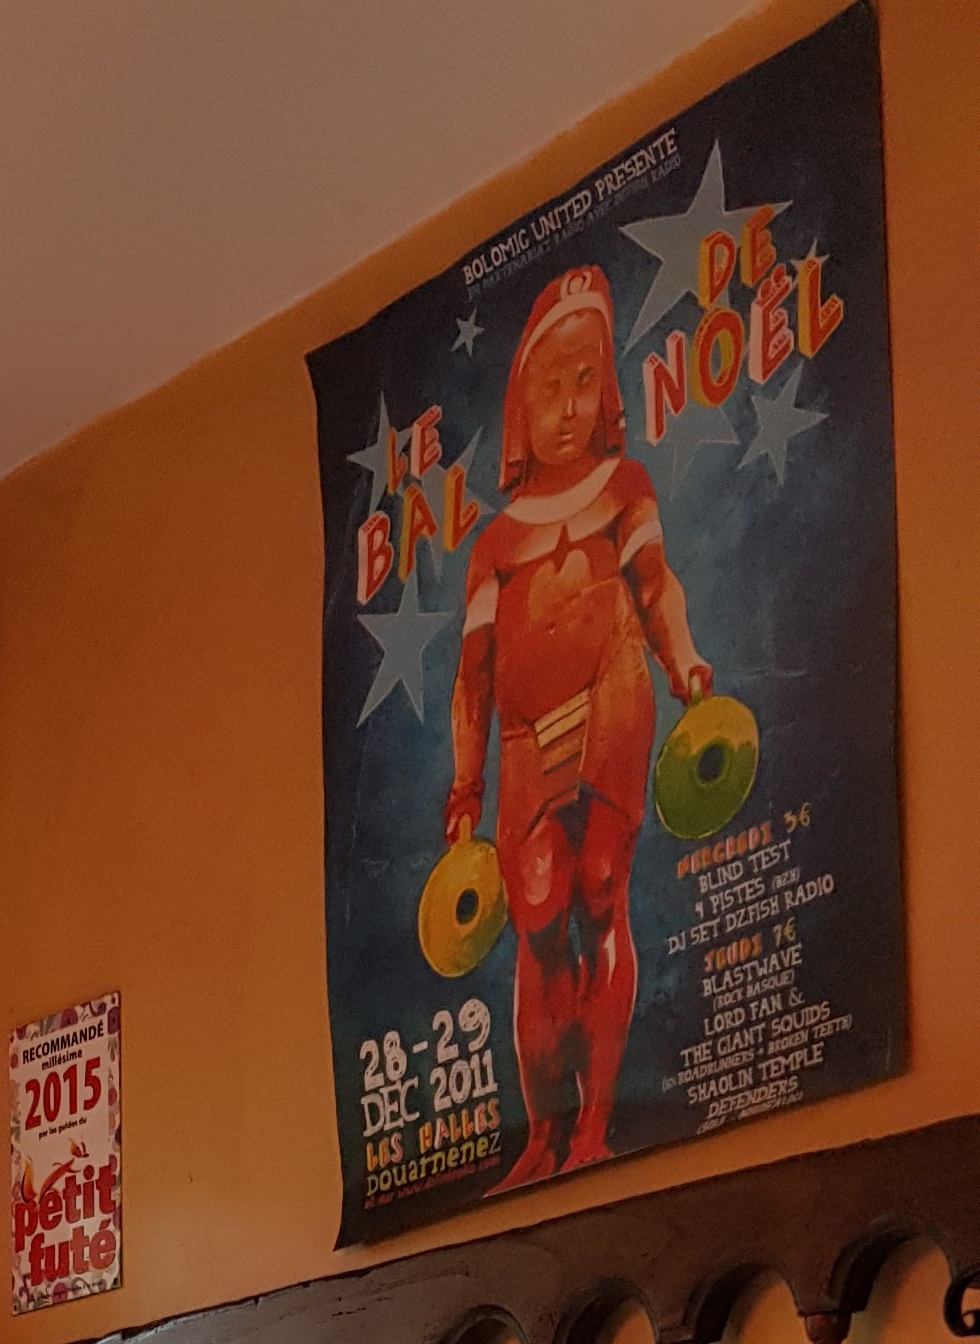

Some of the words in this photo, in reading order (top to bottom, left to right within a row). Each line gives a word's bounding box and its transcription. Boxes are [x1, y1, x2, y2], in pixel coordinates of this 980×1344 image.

[463, 229, 529, 285] BOLOMIC
[531, 190, 592, 240] UNITED
[595, 128, 678, 200] PRESENTE
[698, 204, 777, 308] DE
[643, 255, 843, 446] NOËL
[387, 404, 442, 495] LE
[357, 463, 480, 605] BAL
[698, 861, 744, 895] BLIND
[748, 838, 792, 873] TEST
[709, 877, 766, 915] PISTES
[667, 931, 687, 955] DJ
[690, 918, 722, 945] SET
[783, 873, 835, 910] RADIO
[702, 942, 803, 997] BLASTWAVE
[22, 1020, 104, 1065] RECOMMANDÉ
[680, 1040, 713, 1068] THE
[717, 1022, 766, 1056] GIANT
[771, 1001, 831, 1038] SQUIDS
[703, 1007, 745, 1036] LORD
[749, 993, 783, 1021] FAN
[788, 987, 805, 1007] &
[25, 1056, 101, 1131] 2015
[41, 1048, 83, 1071] millésime
[360, 1076, 420, 1137] DEC
[429, 1048, 498, 1112] 2011
[686, 1066, 754, 1105] SHAOLIN
[758, 1041, 825, 1081] TEMPLE
[707, 1075, 799, 1120] DEFENDERS
[366, 1132, 403, 1172] LES
[419, 1097, 500, 1154] HALLES
[14, 1161, 117, 1254] petit
[29, 1219, 117, 1287] futé
